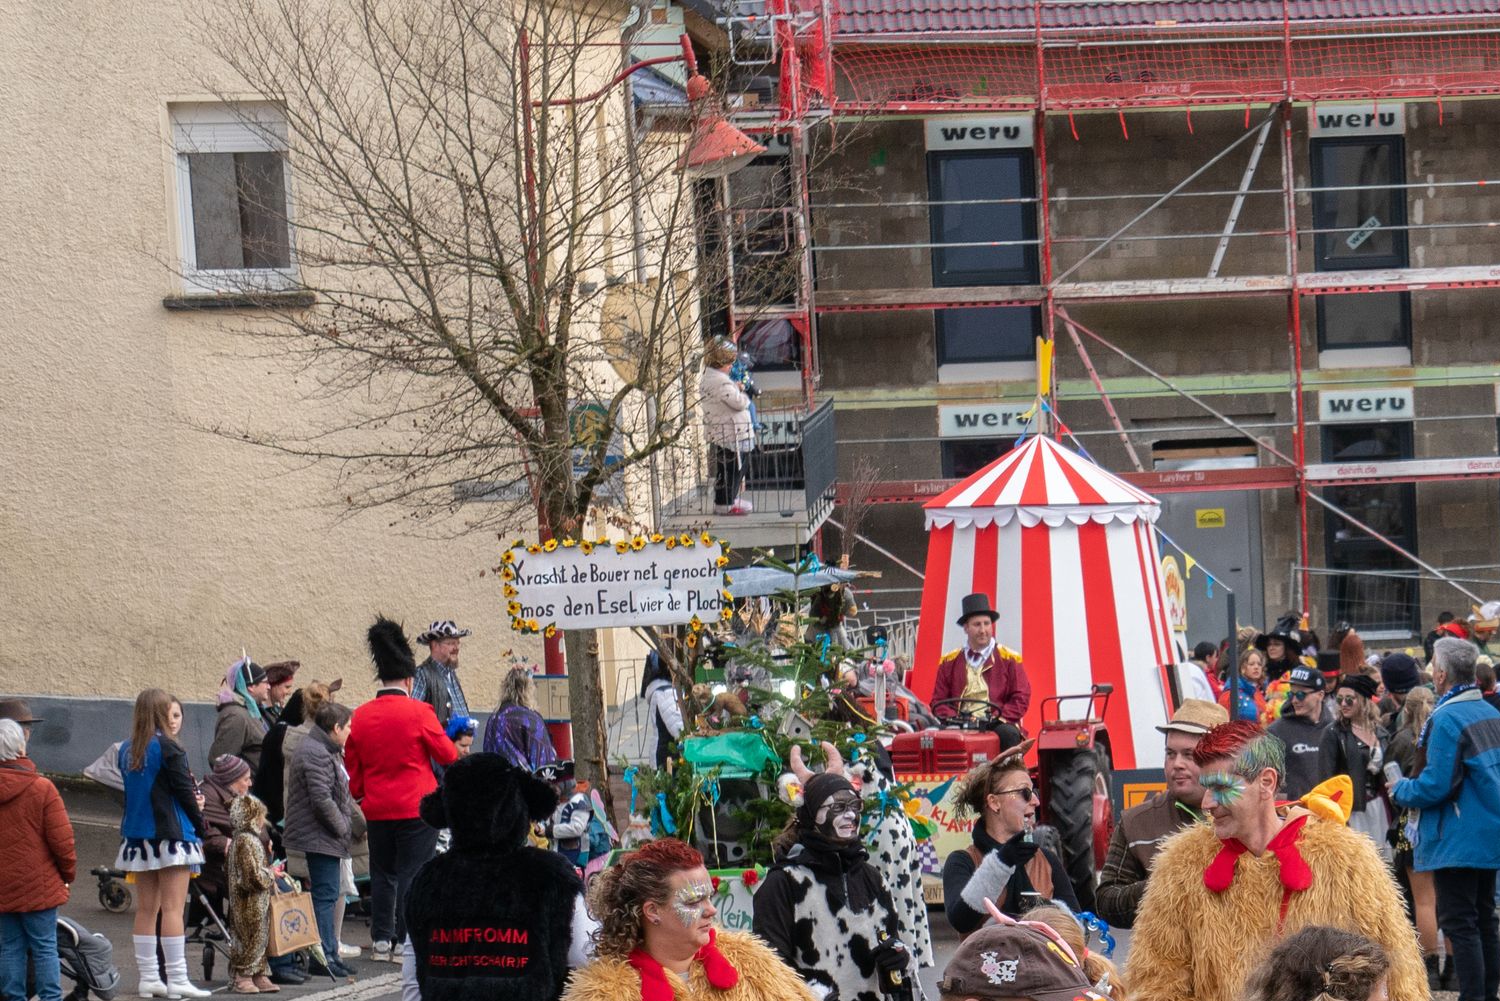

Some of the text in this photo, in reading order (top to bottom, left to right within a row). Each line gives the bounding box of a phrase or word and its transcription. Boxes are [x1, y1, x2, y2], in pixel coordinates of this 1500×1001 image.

[1319, 110, 1396, 128] weru
[941, 125, 1020, 141] weru
[1329, 396, 1406, 413] weru
[511, 558, 718, 590] Krascht de Bouer net genoch
[520, 603, 555, 619] mos
[564, 595, 594, 616] den
[640, 597, 664, 612] vier
[668, 593, 681, 610] de
